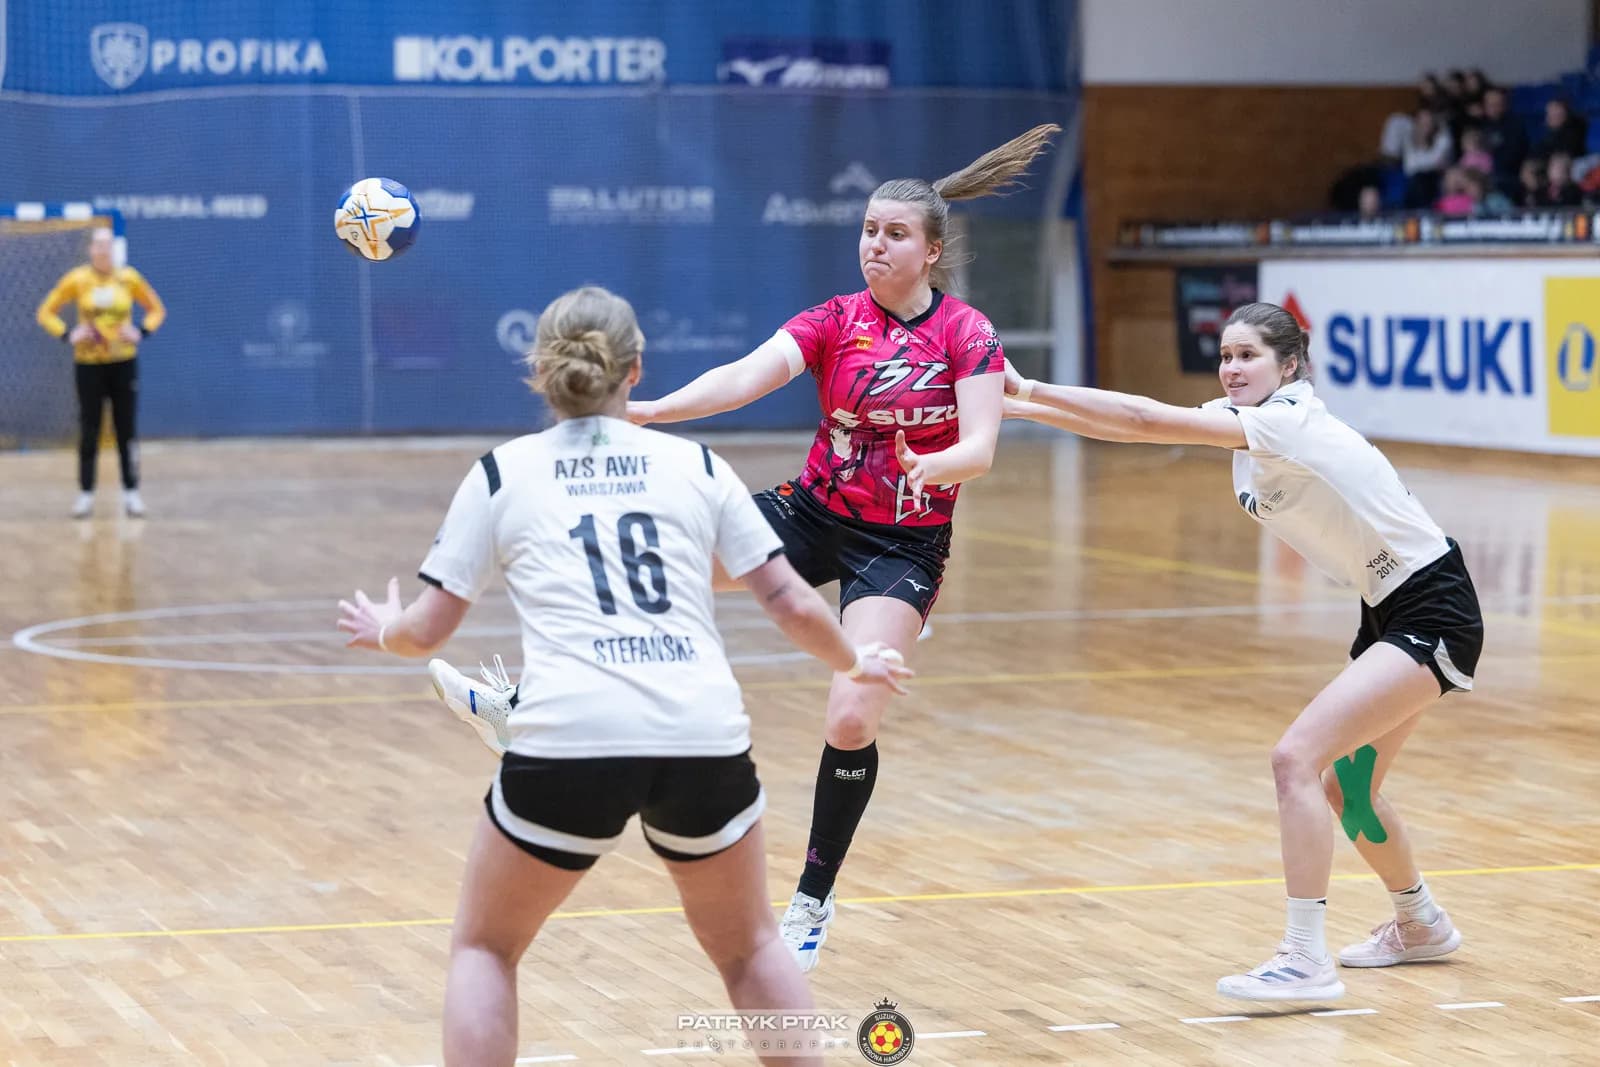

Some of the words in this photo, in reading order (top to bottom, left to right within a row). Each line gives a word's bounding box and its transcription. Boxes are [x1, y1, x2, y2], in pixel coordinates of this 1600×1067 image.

[151, 38, 328, 75] PROFIKA
[421, 35, 667, 82] KOLPORTER
[1325, 313, 1533, 397] SUZUKI
[868, 357, 951, 397] 32
[554, 455, 596, 481] AZS
[606, 454, 652, 478] AWF
[565, 480, 647, 497] WARSZAWA
[568, 511, 673, 616] 16
[1365, 548, 1389, 569] Yogi
[1376, 558, 1399, 580] 2011
[835, 768, 867, 777] SELECT
